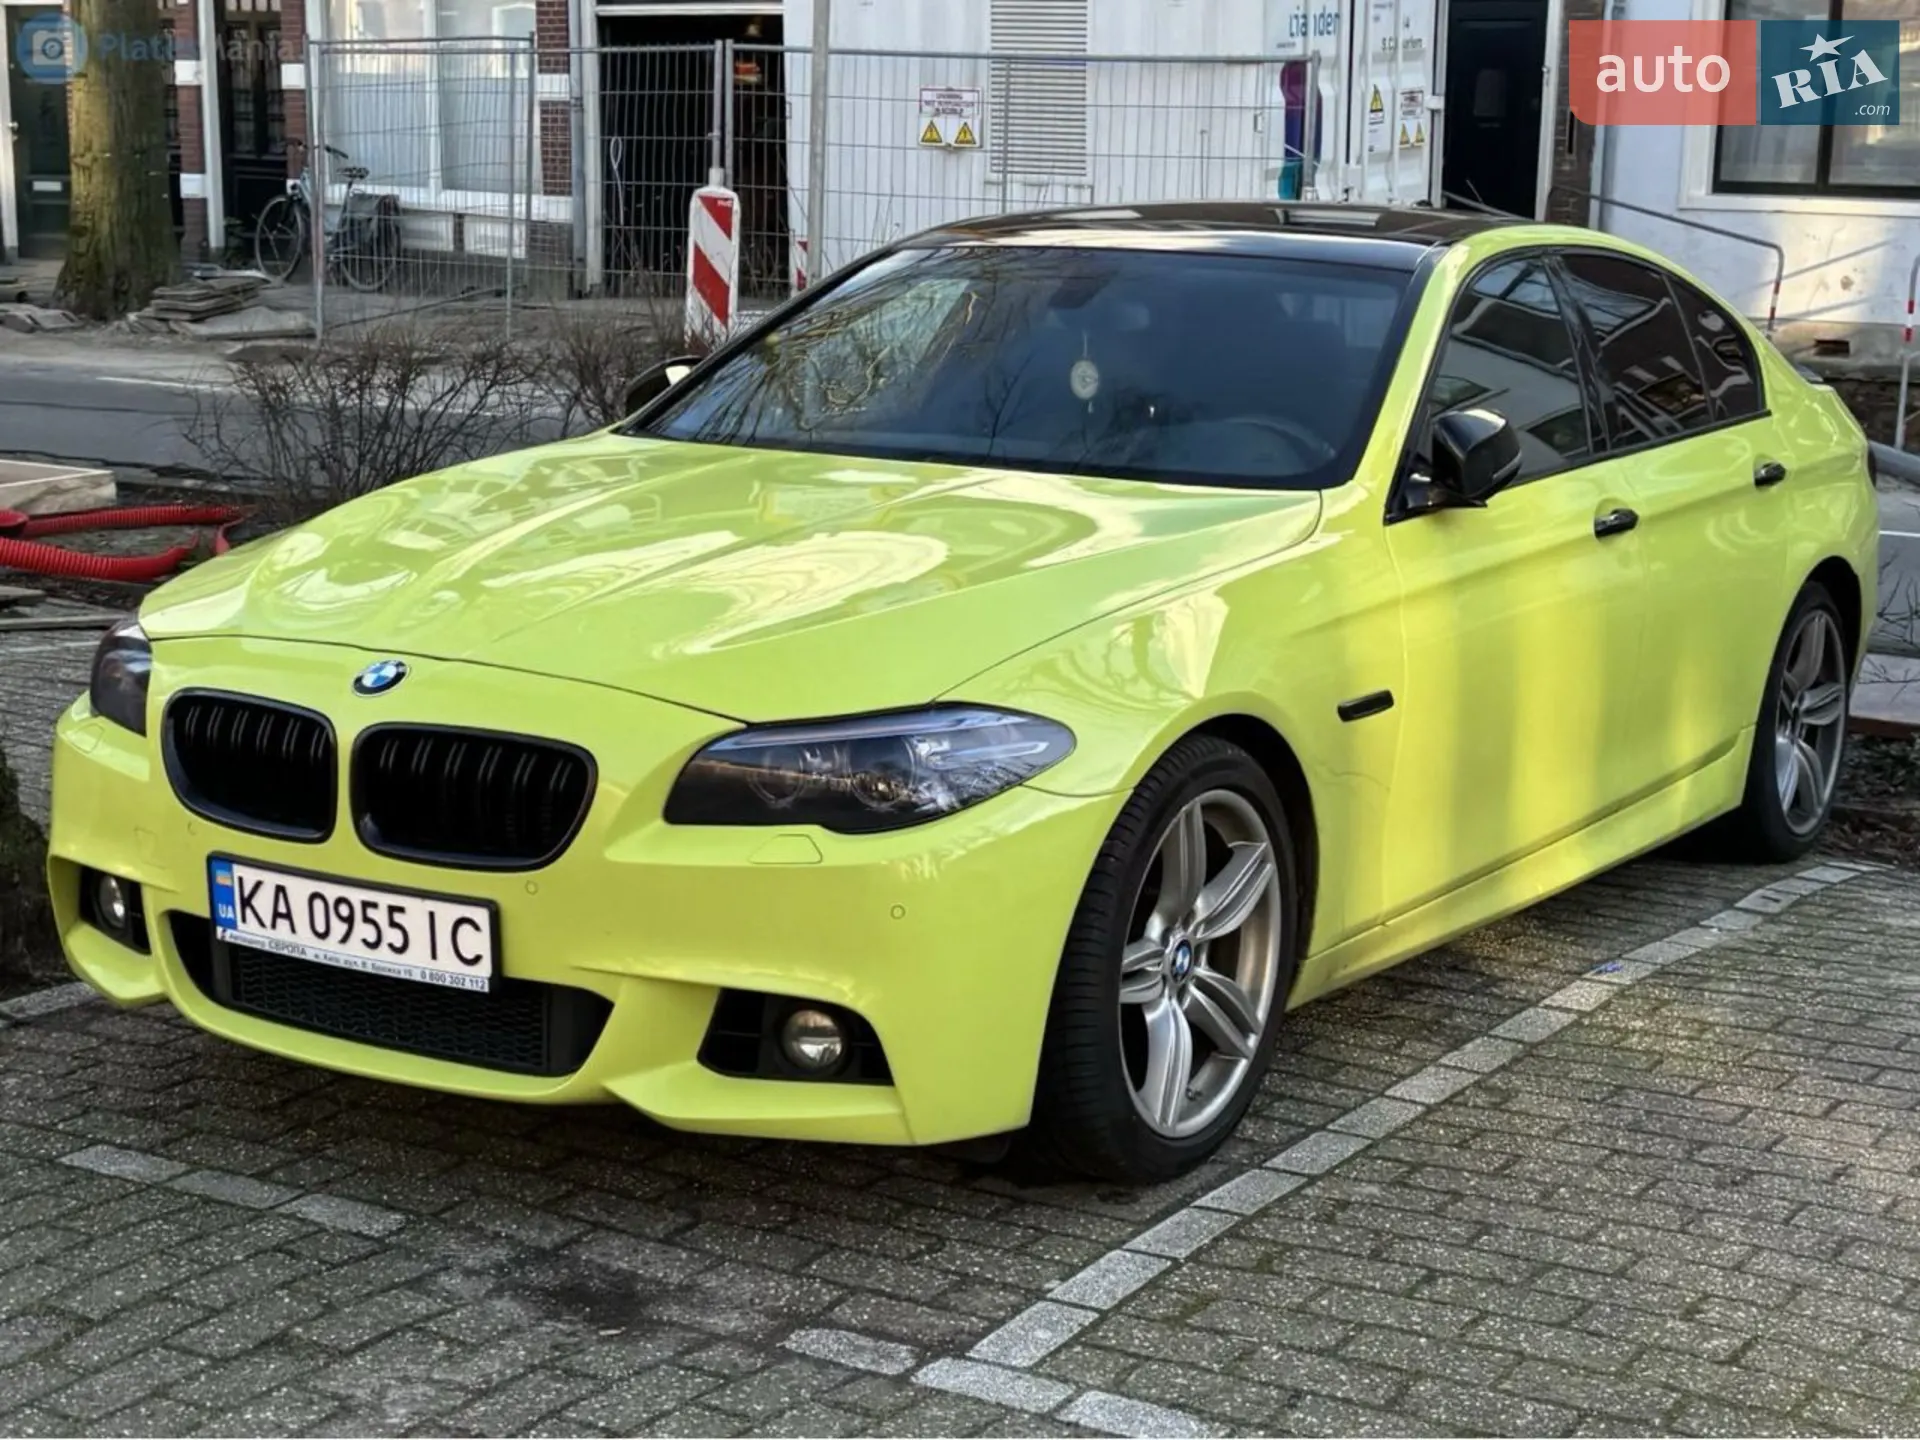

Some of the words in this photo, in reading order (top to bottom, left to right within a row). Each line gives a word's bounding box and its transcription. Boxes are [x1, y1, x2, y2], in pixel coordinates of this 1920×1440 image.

[218, 903, 235, 919] UA
[237, 875, 296, 934] KA
[307, 891, 410, 955] 0955
[428, 910, 483, 967] IC
